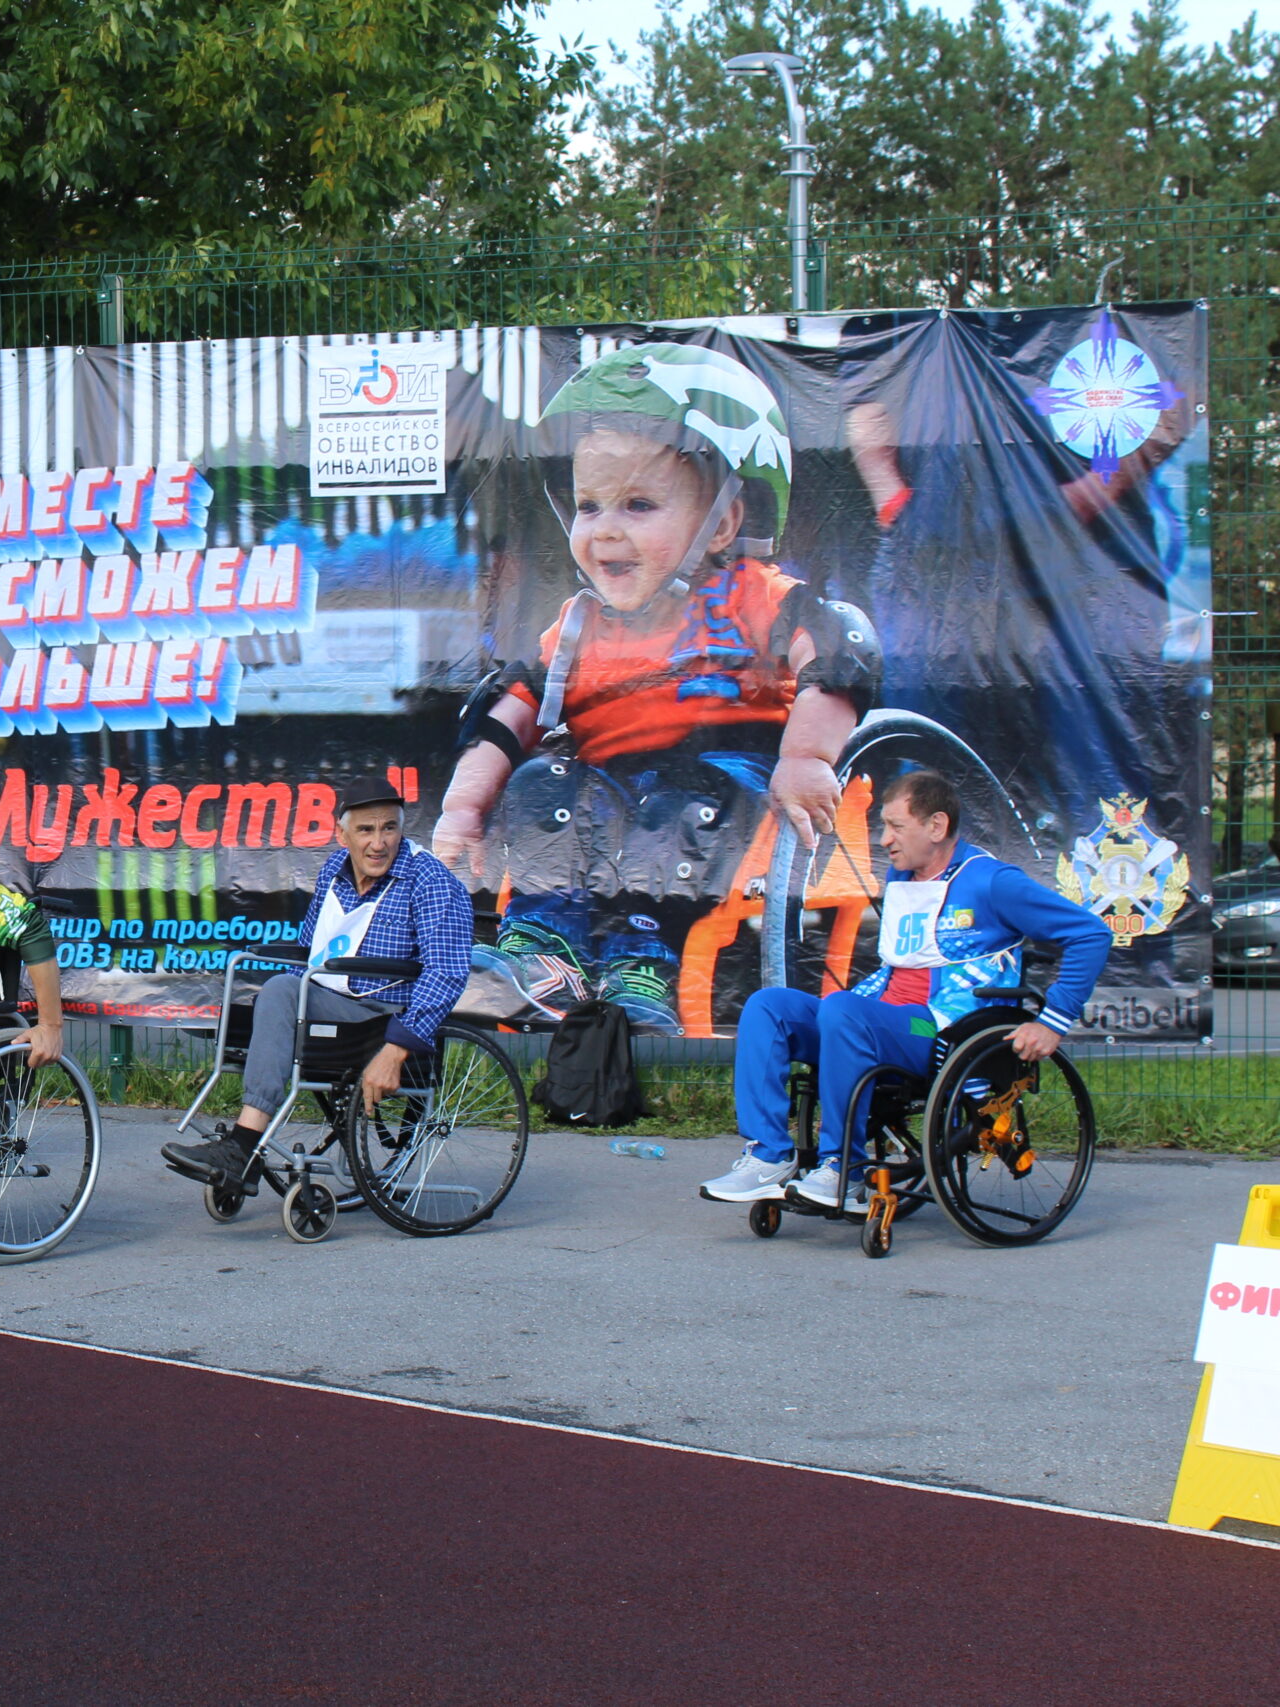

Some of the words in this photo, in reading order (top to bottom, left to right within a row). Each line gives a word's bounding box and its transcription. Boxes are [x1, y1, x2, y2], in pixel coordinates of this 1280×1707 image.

[318, 418, 439, 433] ВСЕРОССИЙСКОЕ
[318, 434, 439, 455] ОБЩЕСТВО
[317, 457, 438, 476] ИНВАЛИДОВ
[109, 919, 144, 939] по
[152, 916, 305, 944] троеборь
[894, 912, 930, 956] 95
[56, 942, 112, 968] ОВЗ
[120, 948, 155, 969] на
[1079, 997, 1198, 1030] unibelt
